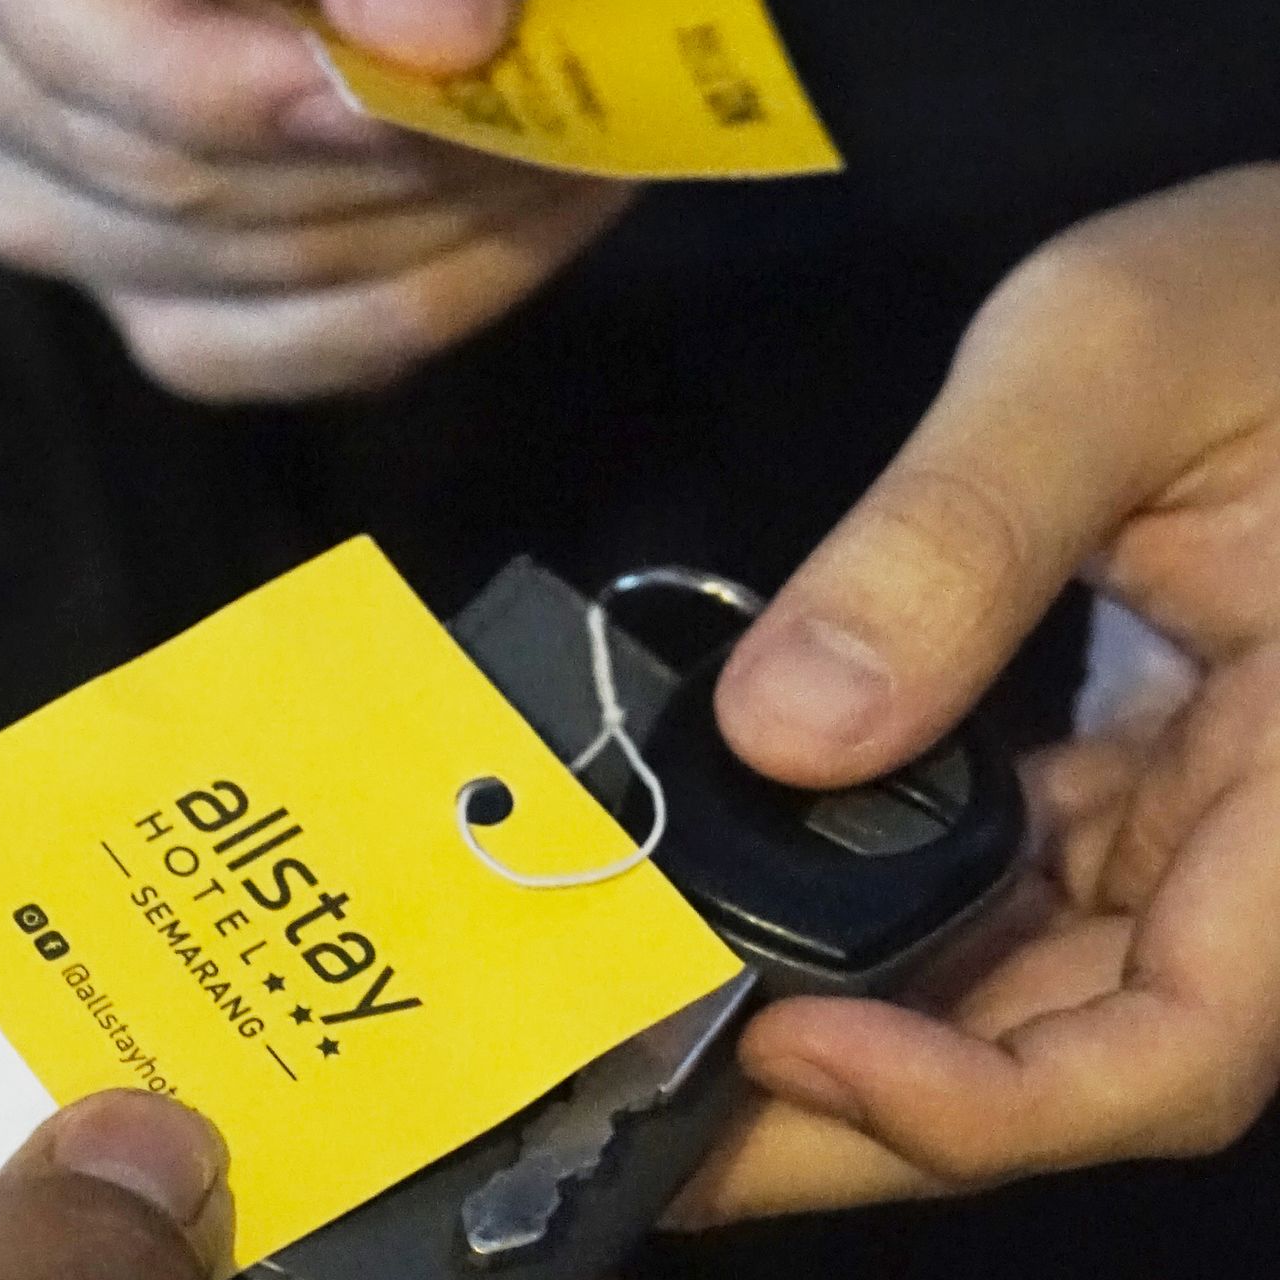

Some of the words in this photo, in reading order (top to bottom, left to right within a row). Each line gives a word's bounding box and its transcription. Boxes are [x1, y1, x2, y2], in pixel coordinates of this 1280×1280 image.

[131, 884, 265, 1039] SEMARANG
[134, 811, 267, 966] HOTEL
[176, 780, 423, 1025] allstay
